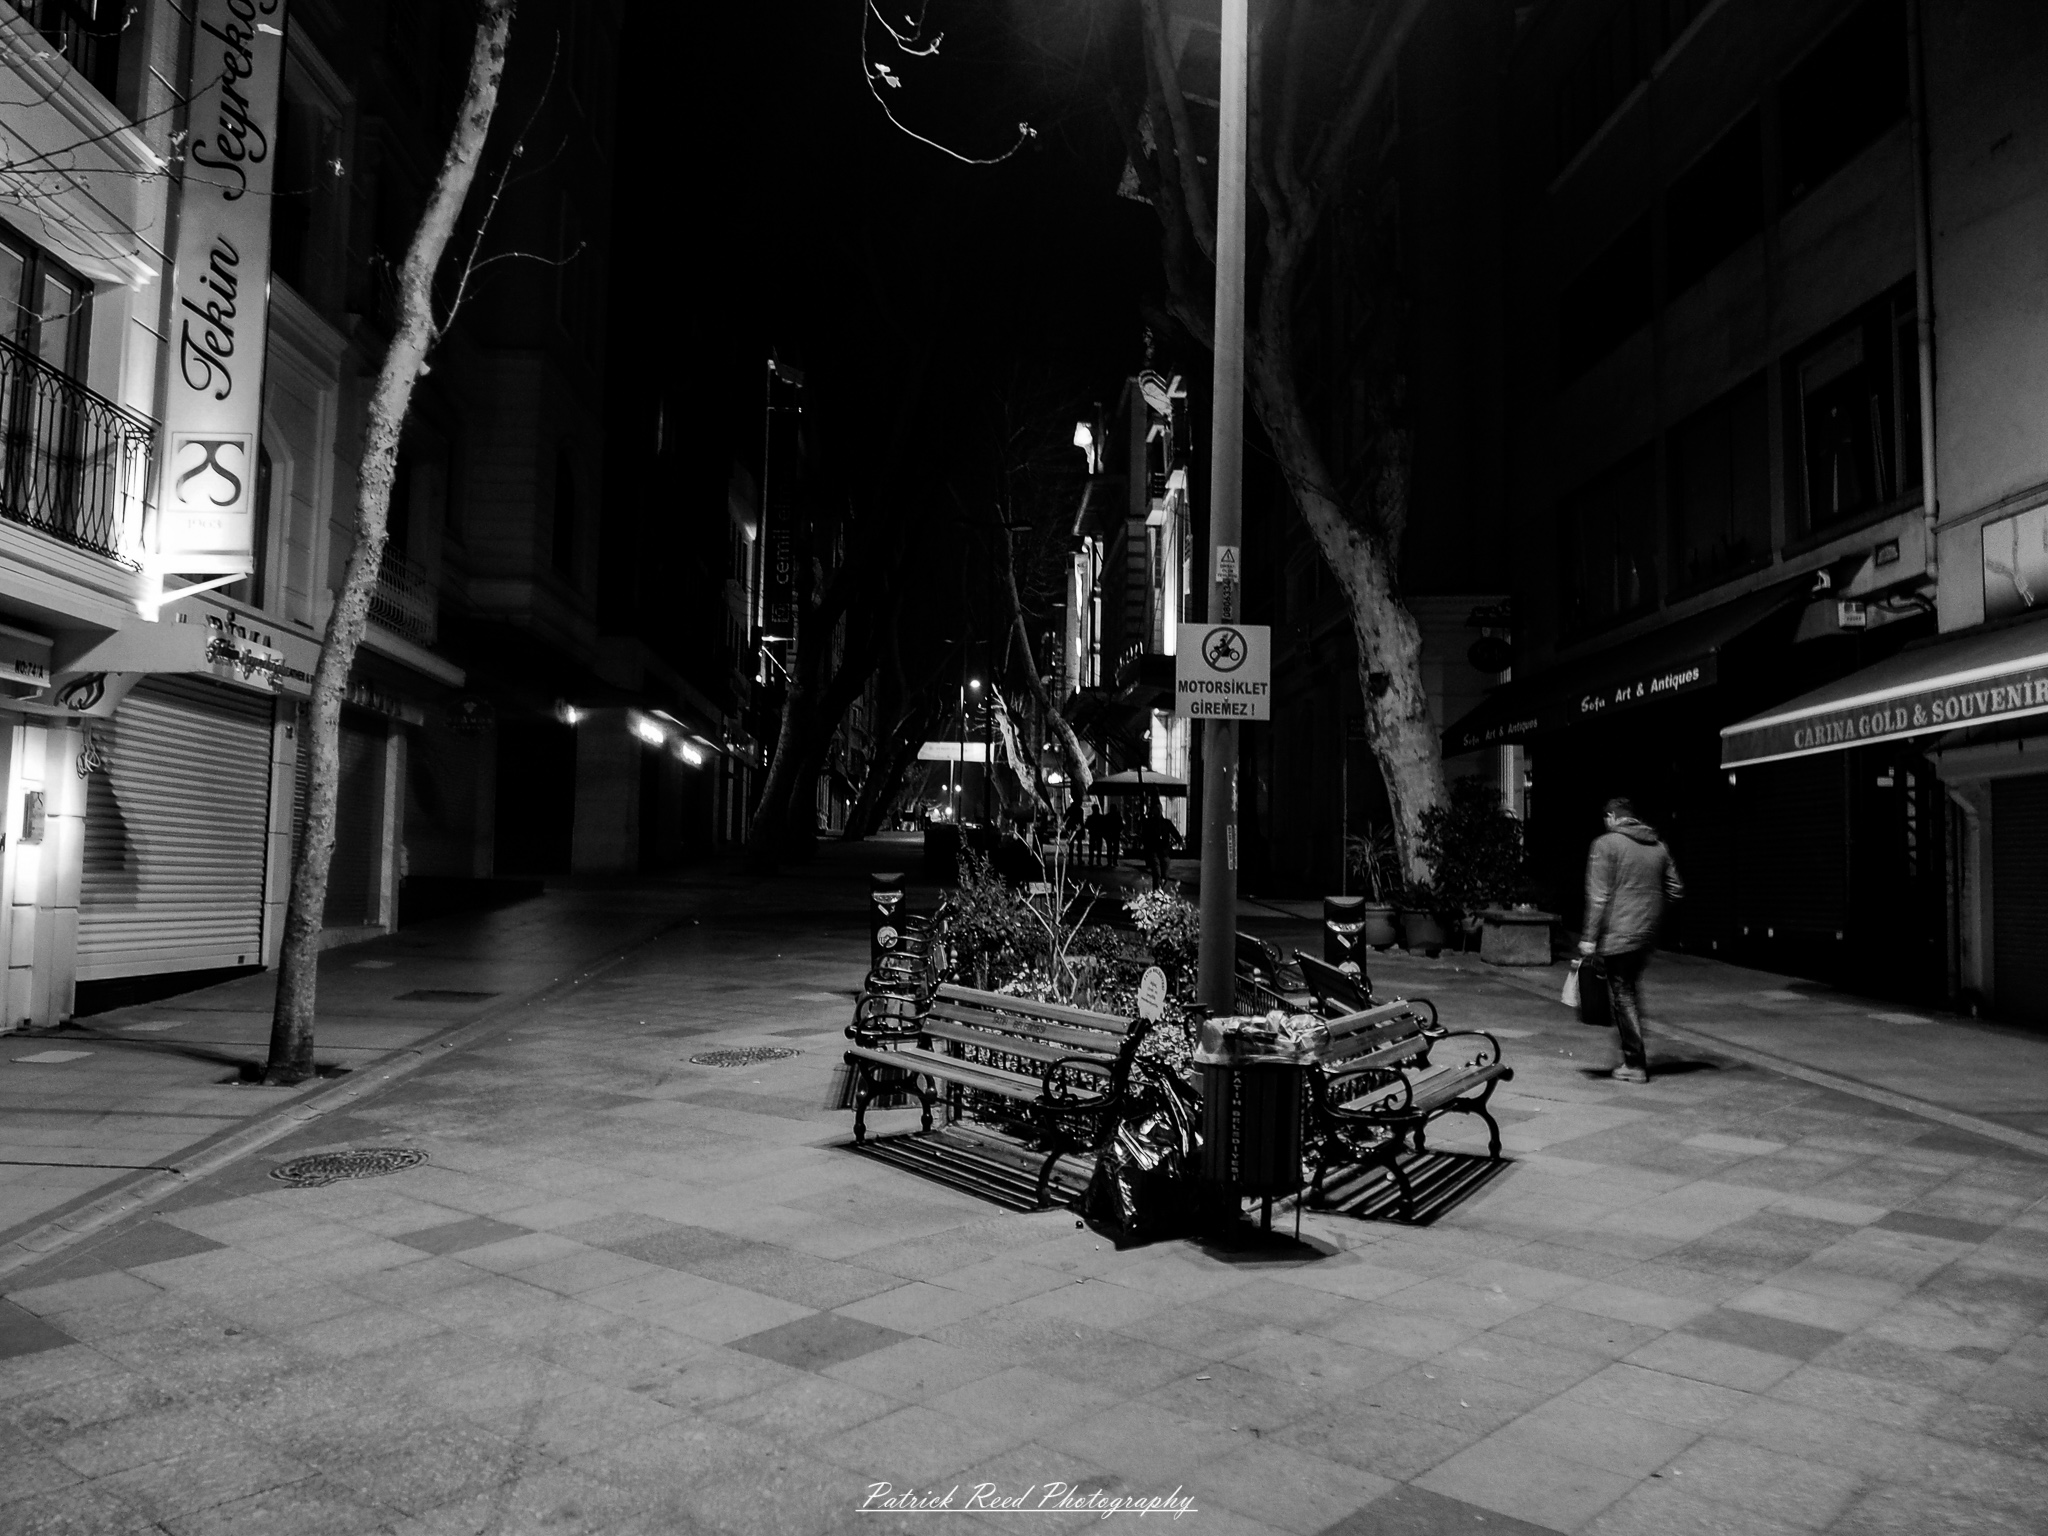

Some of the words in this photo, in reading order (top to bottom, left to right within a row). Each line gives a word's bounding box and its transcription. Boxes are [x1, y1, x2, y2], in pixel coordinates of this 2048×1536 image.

[191, 0, 278, 202] Seyreko
[180, 236, 240, 401] Tekin
[772, 529, 790, 584] cemil
[1178, 679, 1268, 695] MOTORSİKLET
[1191, 699, 1247, 716] GİREMEZ
[1580, 694, 1605, 712] Sofa
[1615, 686, 1631, 703] Art
[1636, 681, 1645, 697] &
[1650, 667, 1700, 690] Antiques
[1485, 728, 1496, 741] Art
[1498, 725, 1504, 737] &
[1507, 718, 1538, 734] Antiques
[1794, 719, 1857, 749] CARINA
[1859, 707, 1908, 737] GOLD
[1913, 703, 1927, 727] &
